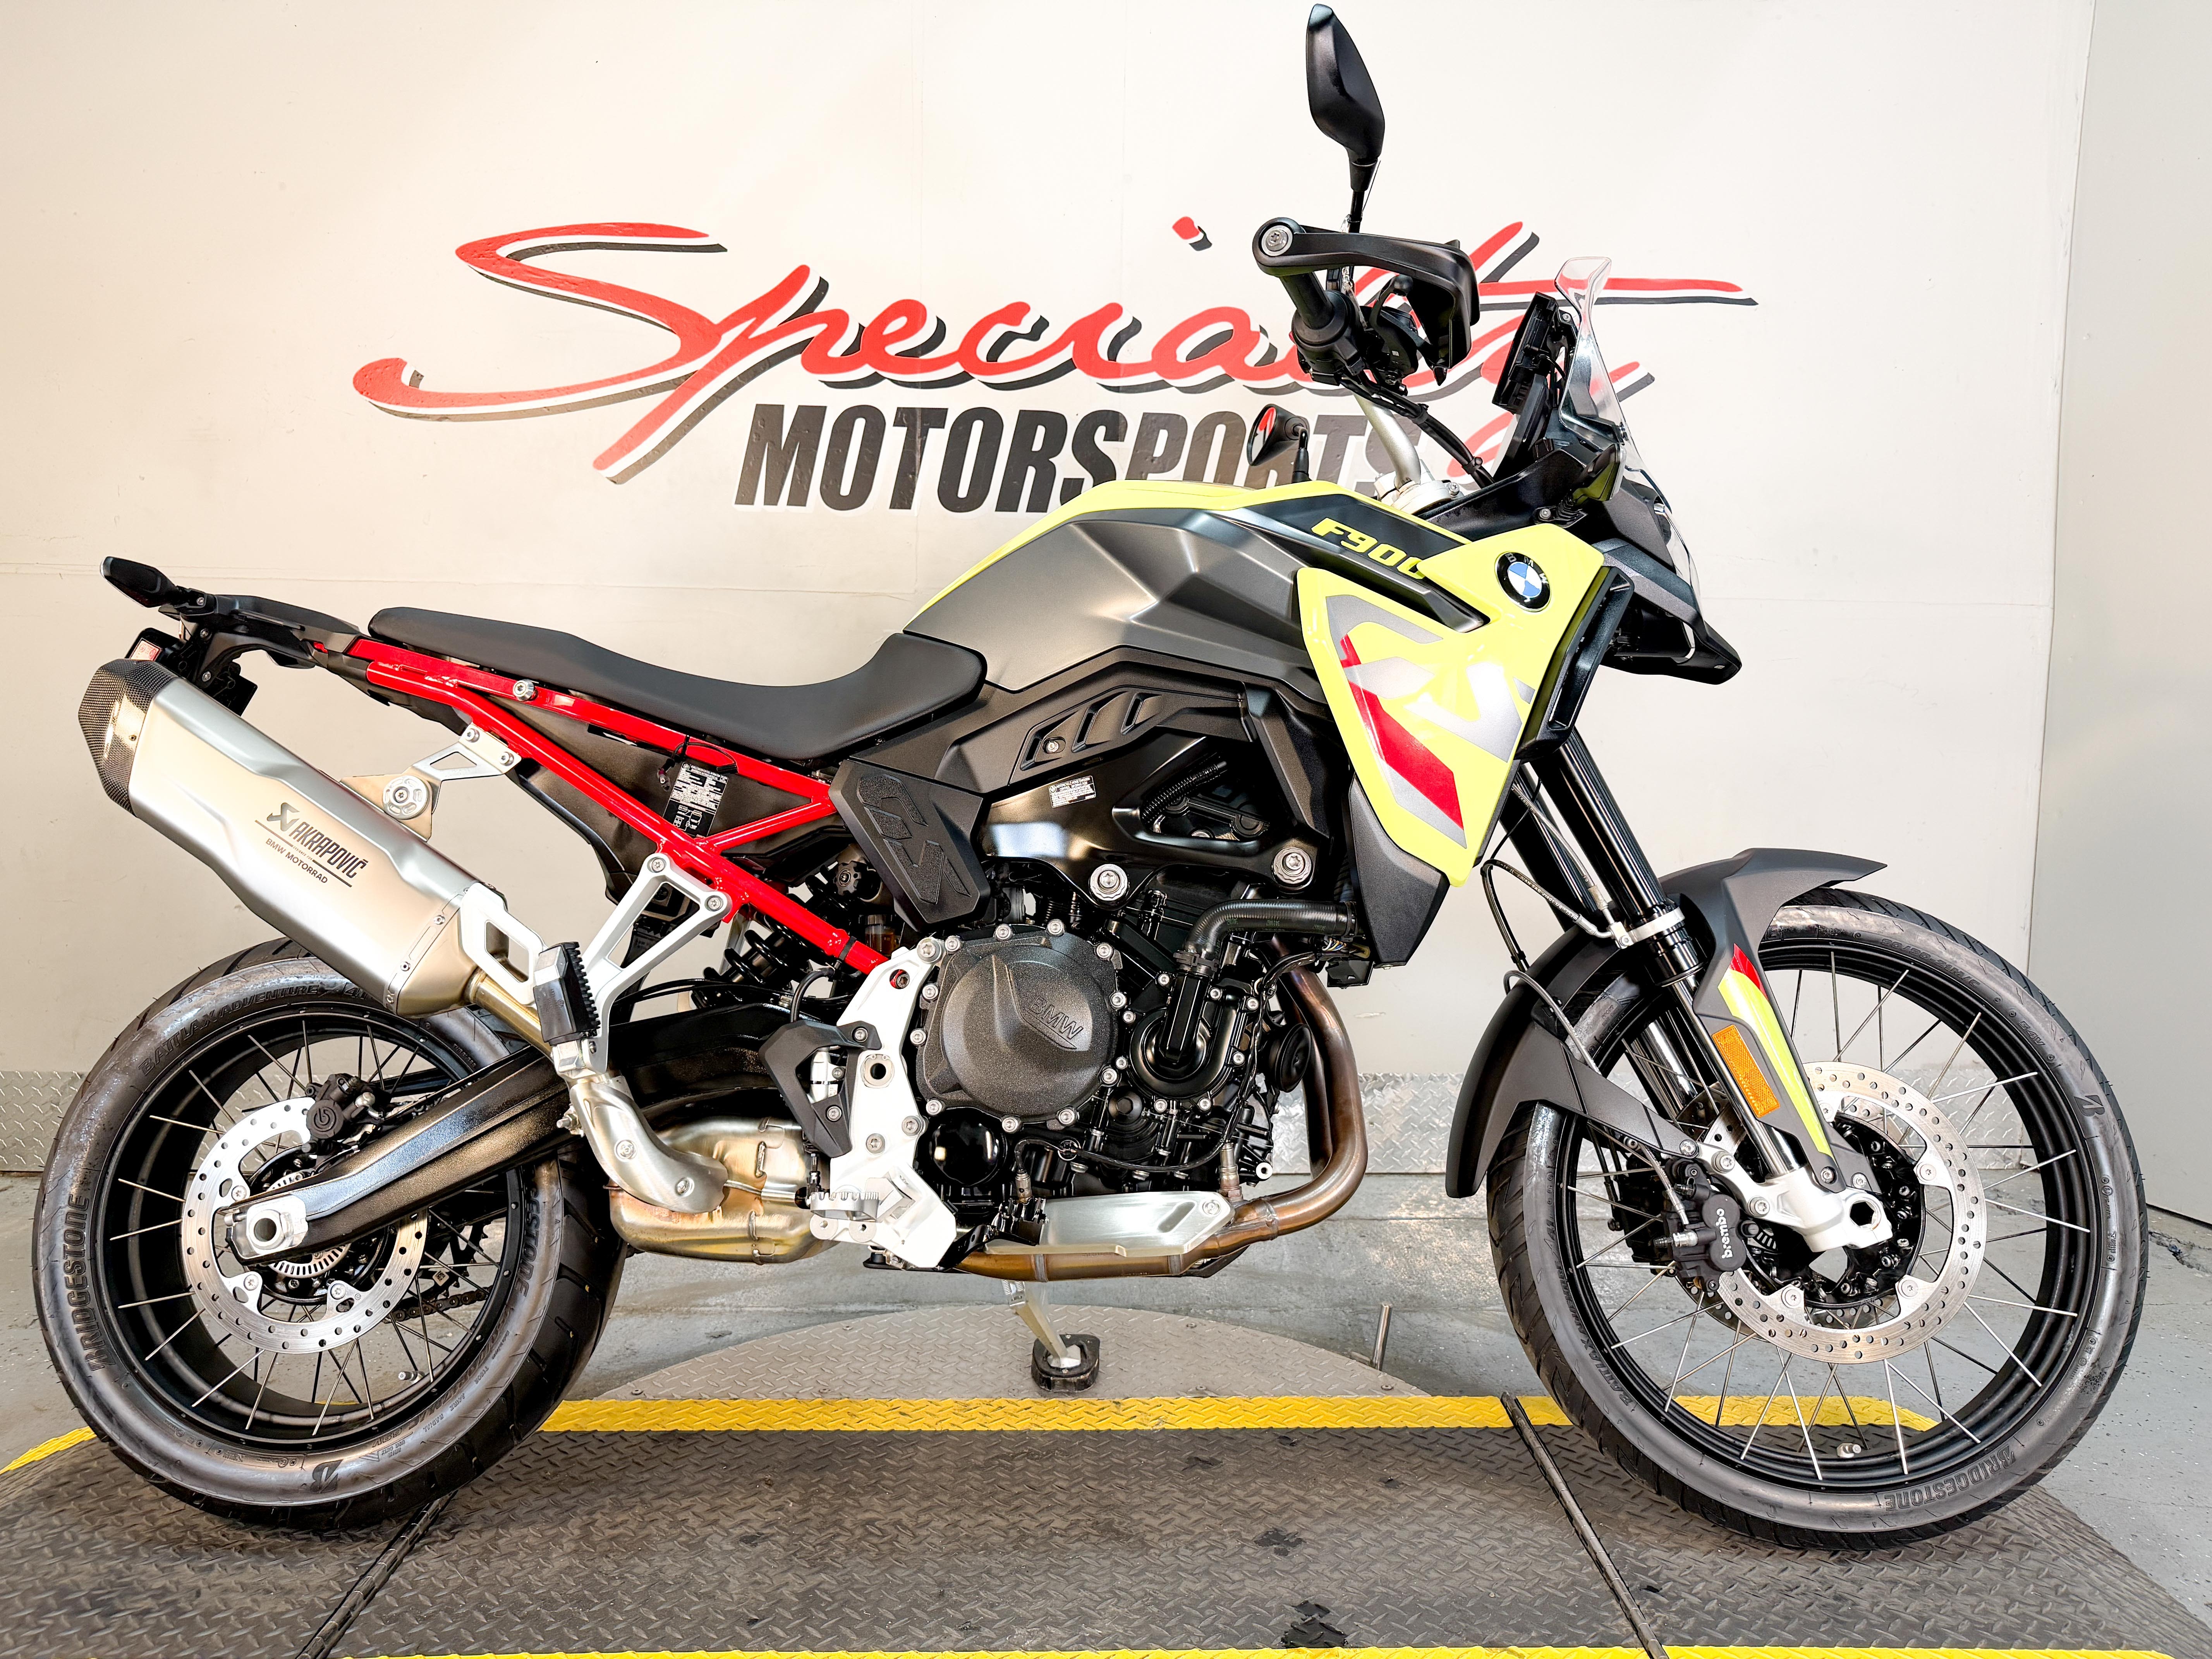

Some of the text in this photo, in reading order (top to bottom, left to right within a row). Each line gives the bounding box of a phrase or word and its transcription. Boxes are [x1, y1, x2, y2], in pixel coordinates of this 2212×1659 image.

[265, 838, 328, 884] BMW MOTORRAD
[137, 1009, 221, 1077] BATTLAX
[216, 984, 319, 1020] ADVENTURE
[1029, 997, 1083, 1040] BMW
[2018, 1019, 2045, 1045] 54V
[1715, 1208, 1733, 1259] brembo
[62, 1193, 116, 1372] BRIDGESTONE
[1580, 1338, 1633, 1407] BATTLAX
[1883, 1443, 2016, 1511] BRIDGESTONE
